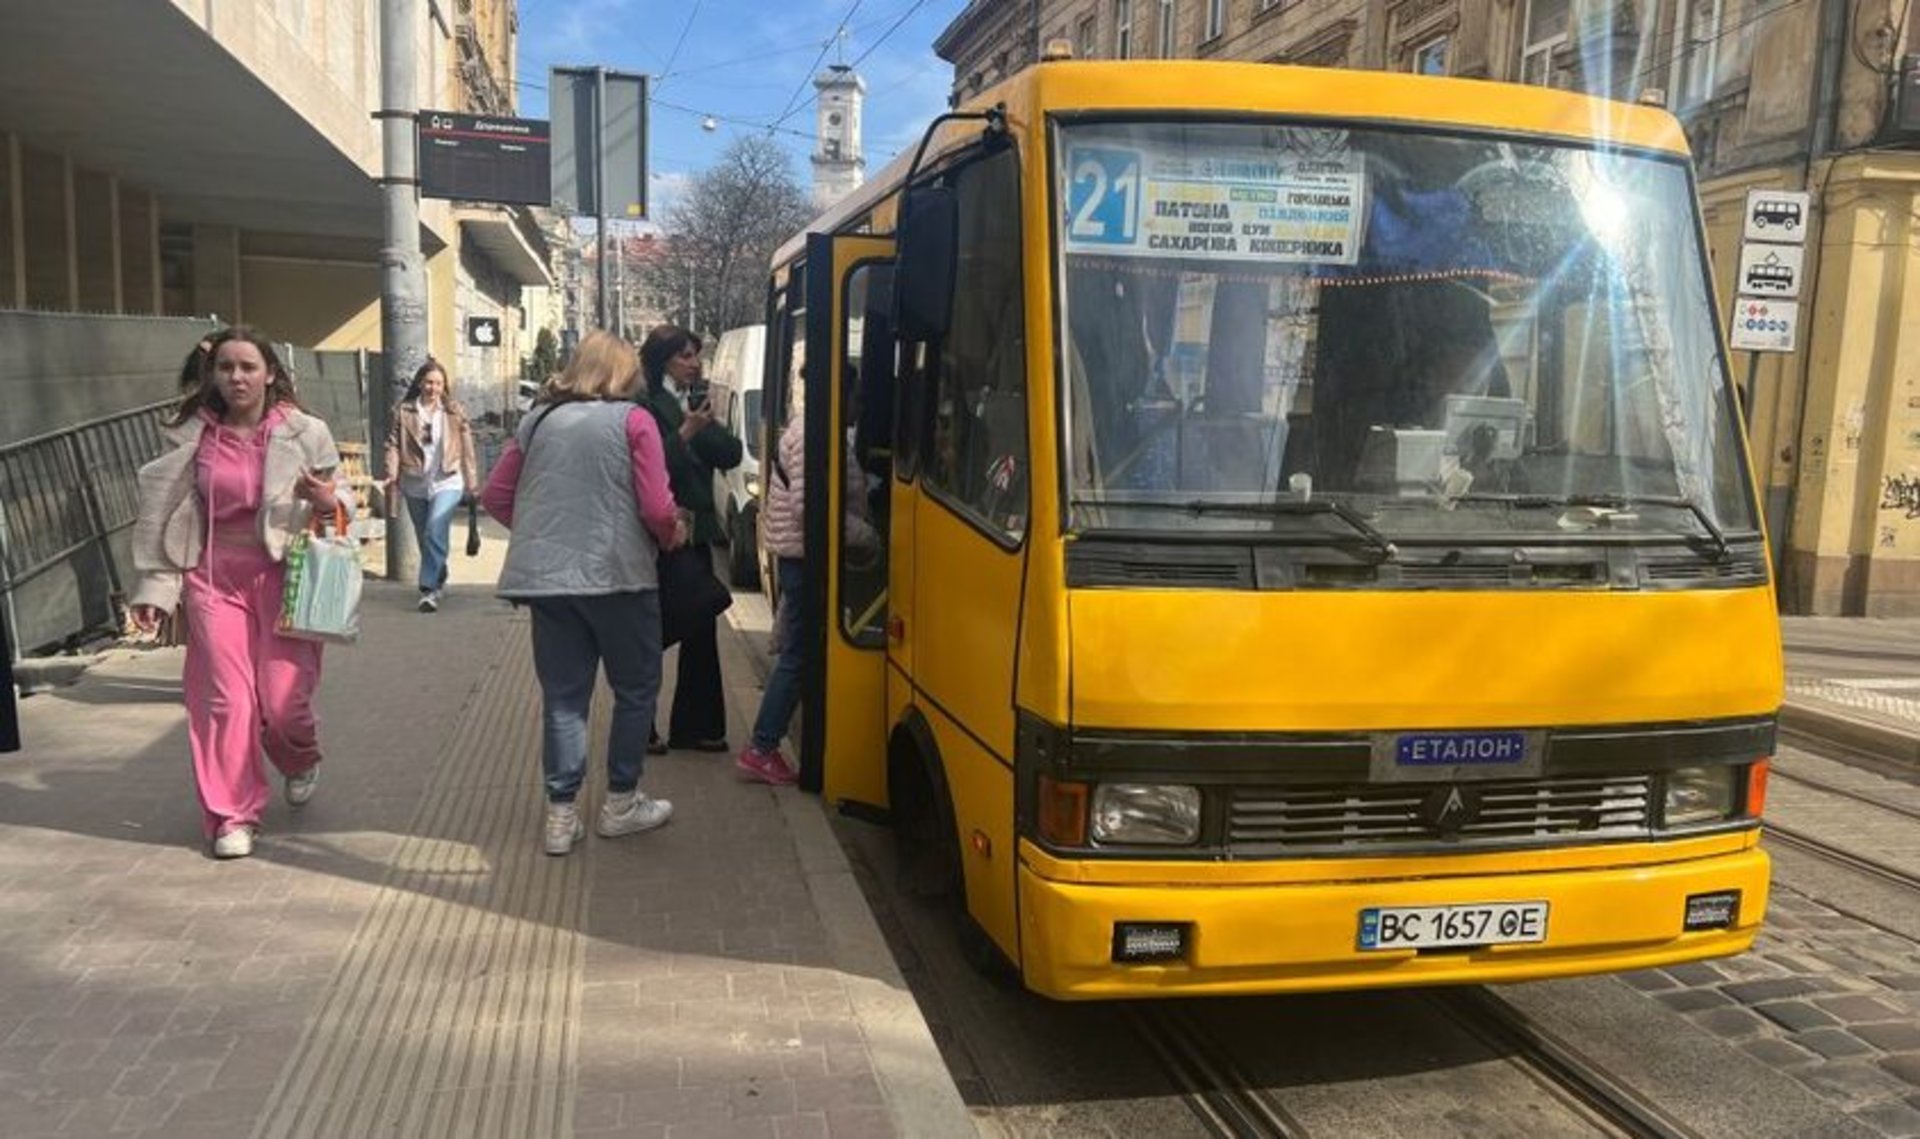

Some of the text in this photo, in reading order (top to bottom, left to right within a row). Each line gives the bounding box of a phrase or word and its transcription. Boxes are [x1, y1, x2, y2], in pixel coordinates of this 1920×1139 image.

[1071, 159, 1137, 238] 21
[1149, 234, 1237, 252] САХАРОВА
[1412, 738, 1511, 760] ЕТАЛОН
[1431, 910, 1492, 940] 1657
